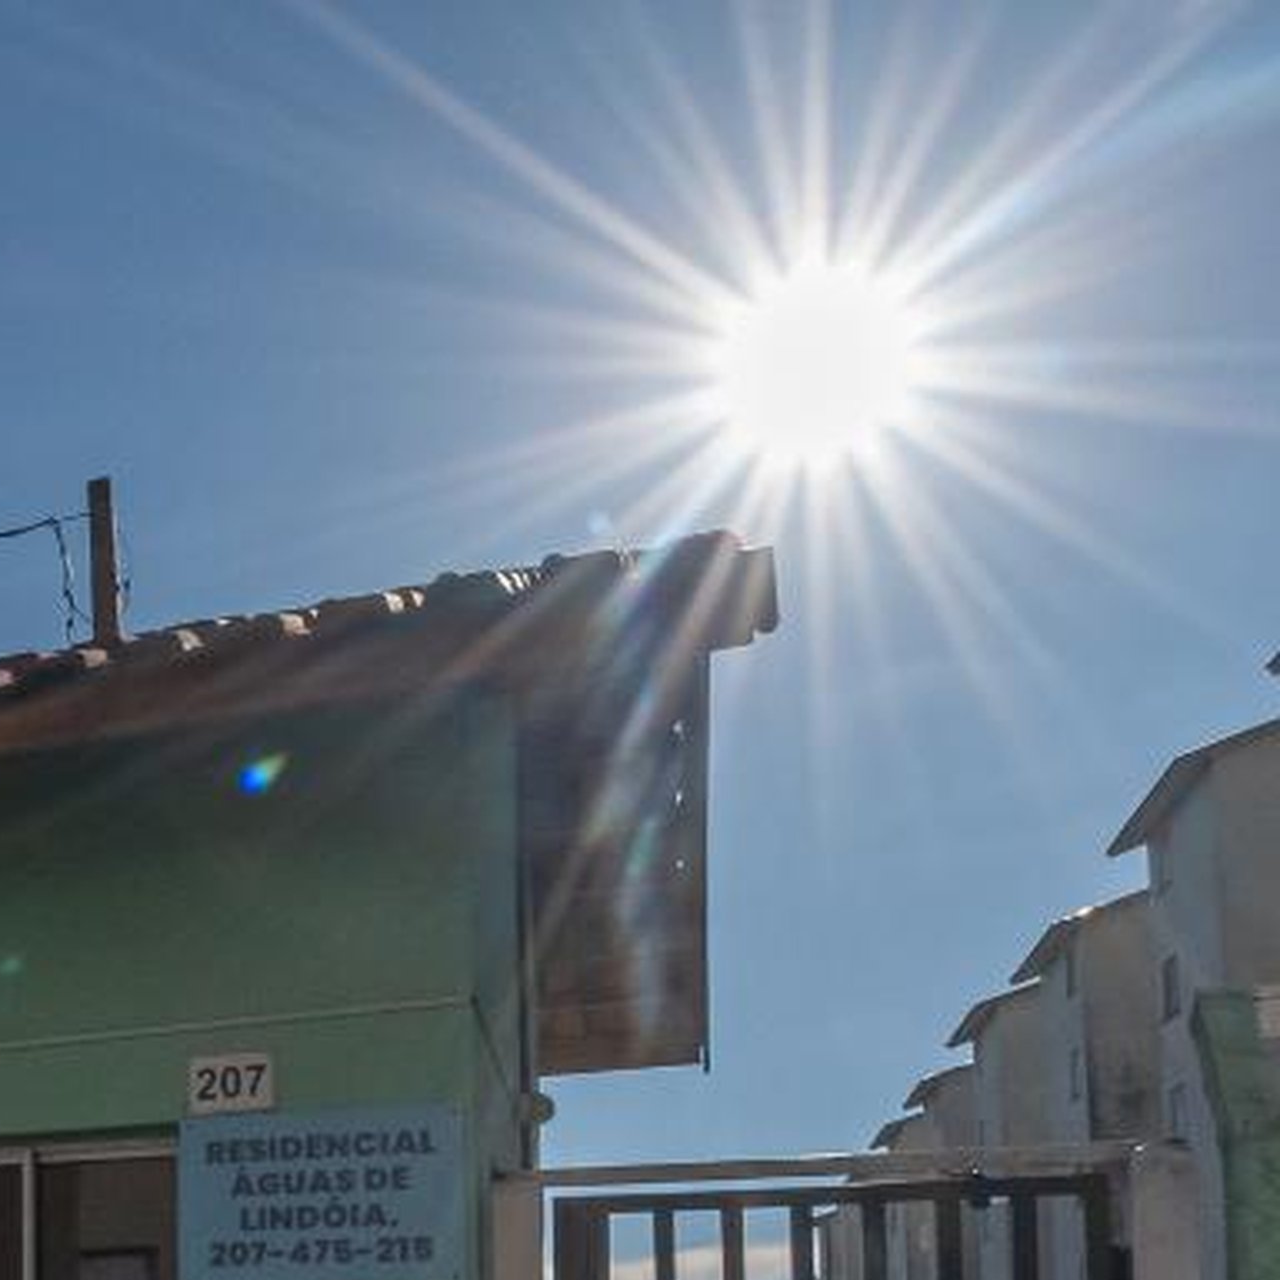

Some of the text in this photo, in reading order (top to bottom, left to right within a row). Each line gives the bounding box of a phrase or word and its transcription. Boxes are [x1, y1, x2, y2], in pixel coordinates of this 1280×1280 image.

[196, 1064, 267, 1101] 207
[205, 1129, 437, 1165] RESIDENCIAL
[232, 1165, 414, 1198] ÁGUAS DE
